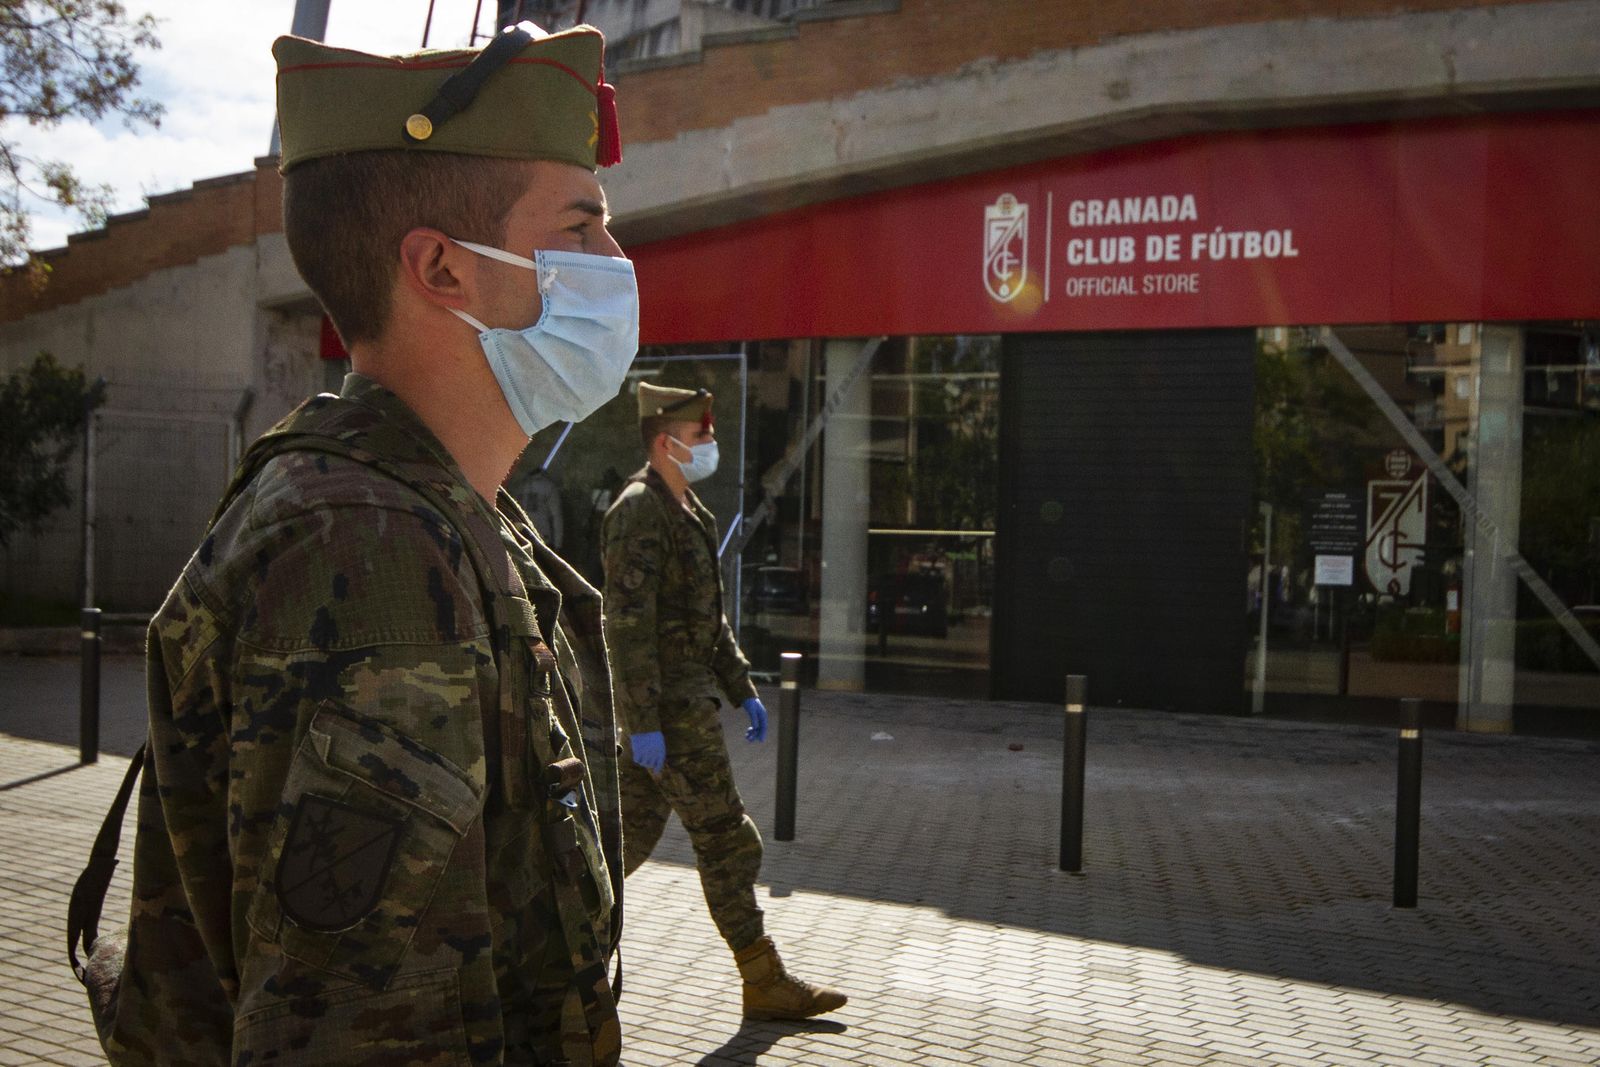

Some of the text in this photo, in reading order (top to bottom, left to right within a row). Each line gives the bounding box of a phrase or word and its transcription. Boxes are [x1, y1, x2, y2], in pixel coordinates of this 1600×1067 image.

[1068, 194, 1198, 228] GRANADA
[1066, 226, 1299, 266] CLUB DE FÚTBOL
[1065, 273, 1200, 297] OFFICIAL STORE
